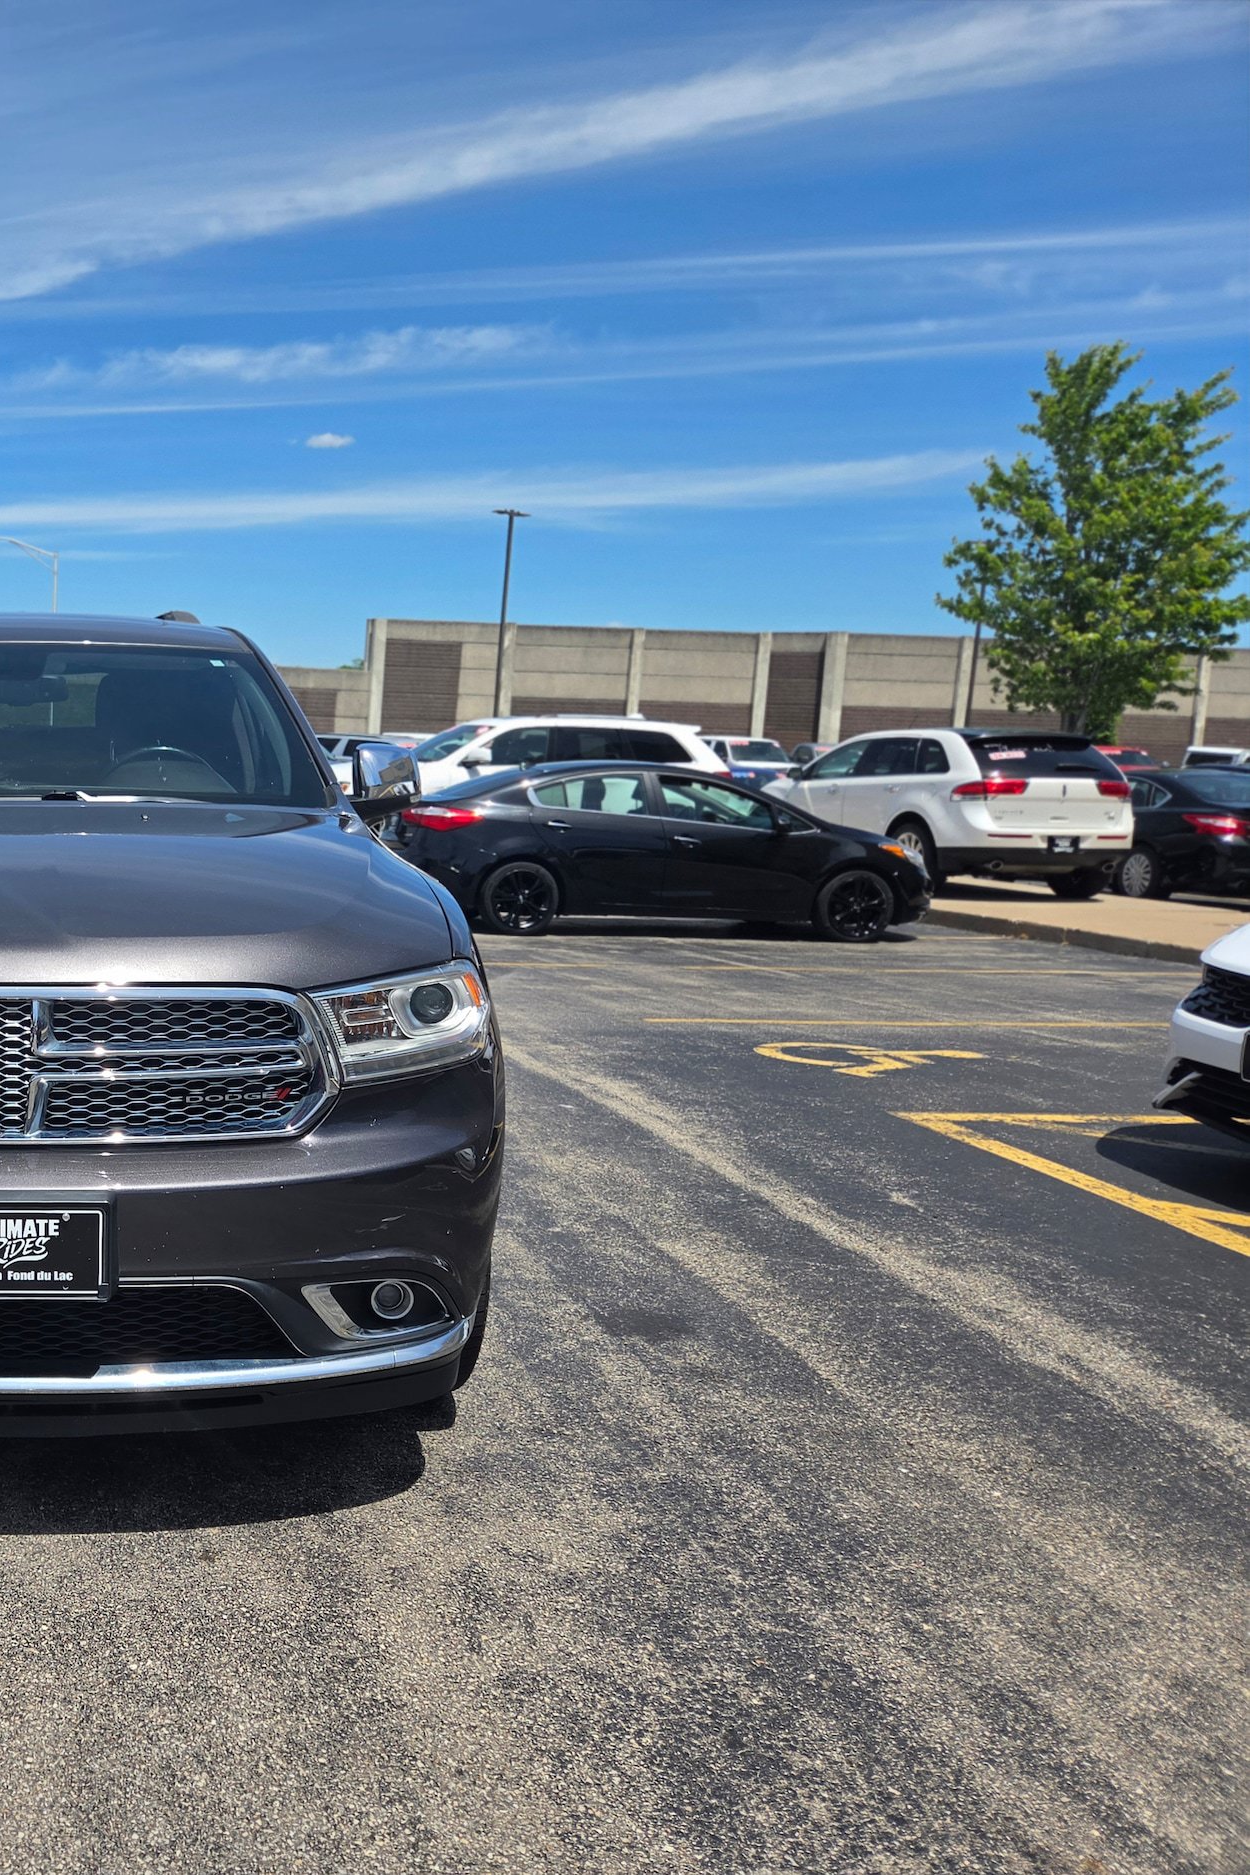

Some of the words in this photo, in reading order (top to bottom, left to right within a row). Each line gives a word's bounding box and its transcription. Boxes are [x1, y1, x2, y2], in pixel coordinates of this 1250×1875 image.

[185, 1091, 280, 1104] DODGE
[7, 1270, 36, 1281] Fond
[37, 1270, 52, 1281] du
[53, 1270, 74, 1281] Lac
